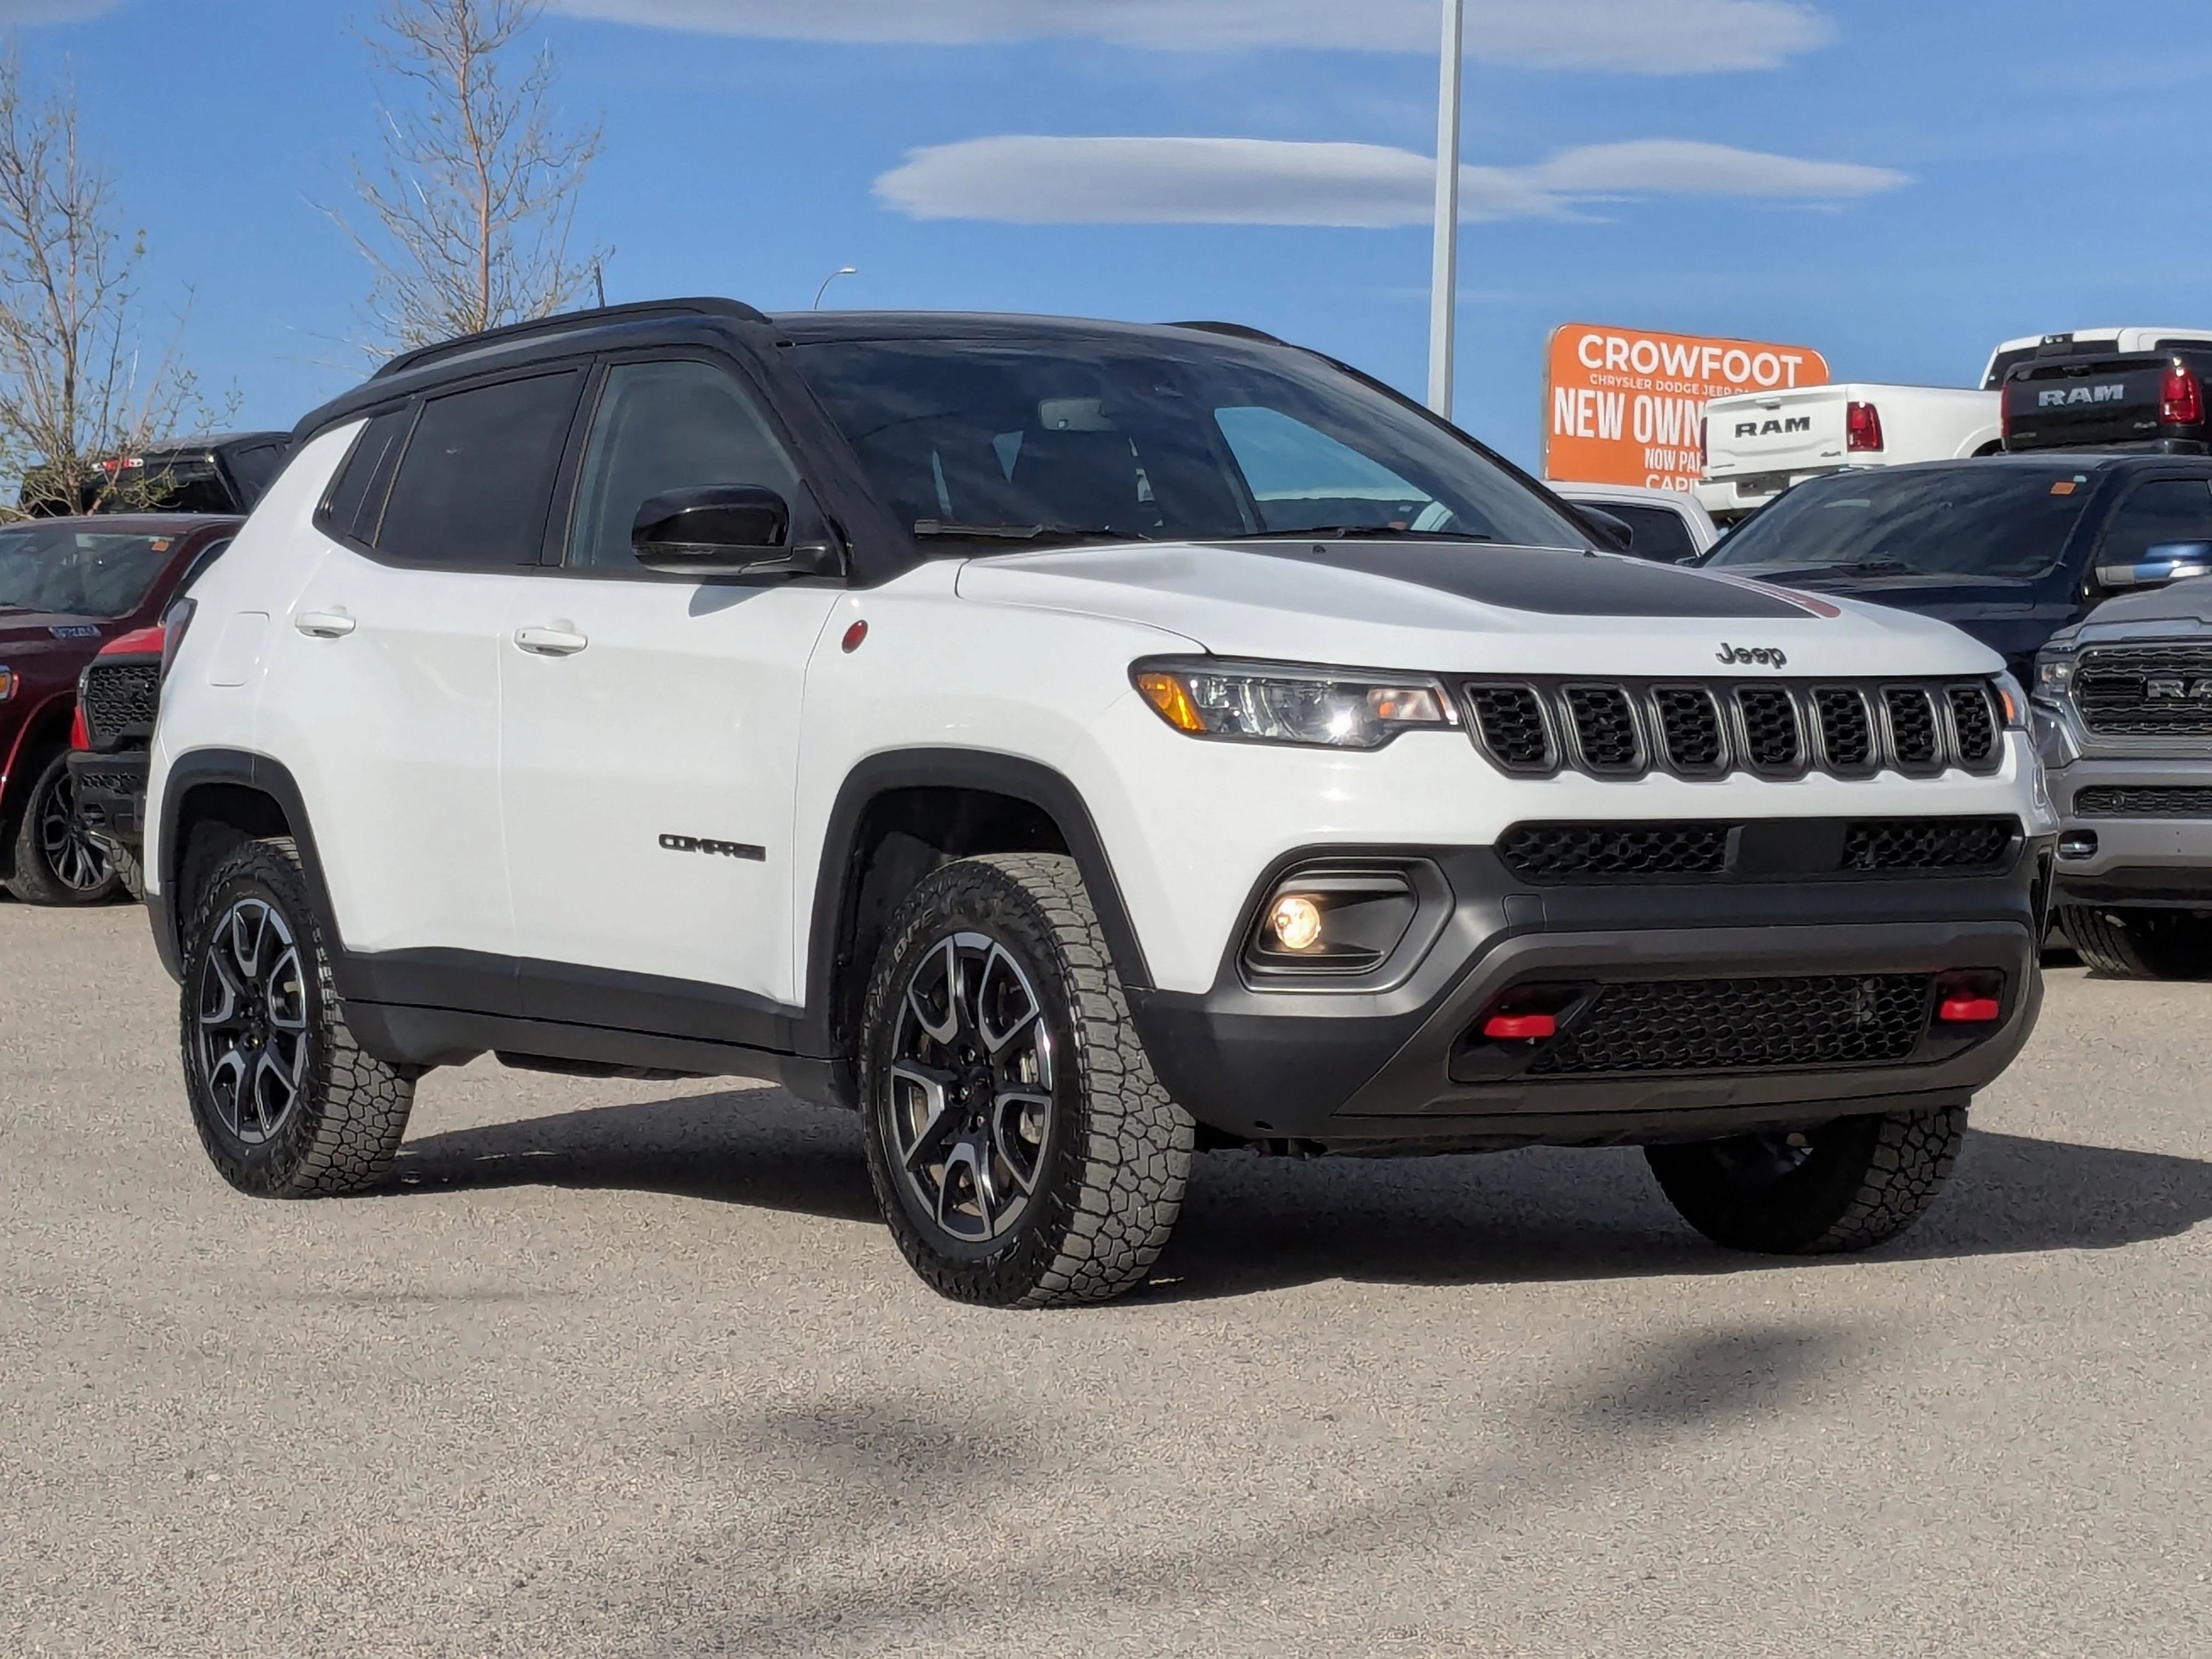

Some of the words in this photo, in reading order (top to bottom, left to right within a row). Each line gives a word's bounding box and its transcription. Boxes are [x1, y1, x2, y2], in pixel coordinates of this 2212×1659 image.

[1578, 334, 1803, 387] CROWFOOT
[1590, 374, 1652, 390] CHRYSLER
[1656, 380, 1700, 395] DODGE
[1702, 384, 1731, 397] JEEP
[2038, 384, 2124, 407] RAM
[1554, 386, 1626, 441] NEW
[1633, 394, 1705, 448] OWN
[1735, 416, 1810, 438] RAM
[1644, 447, 1677, 471] NOW
[1716, 642, 1787, 669] Jeep
